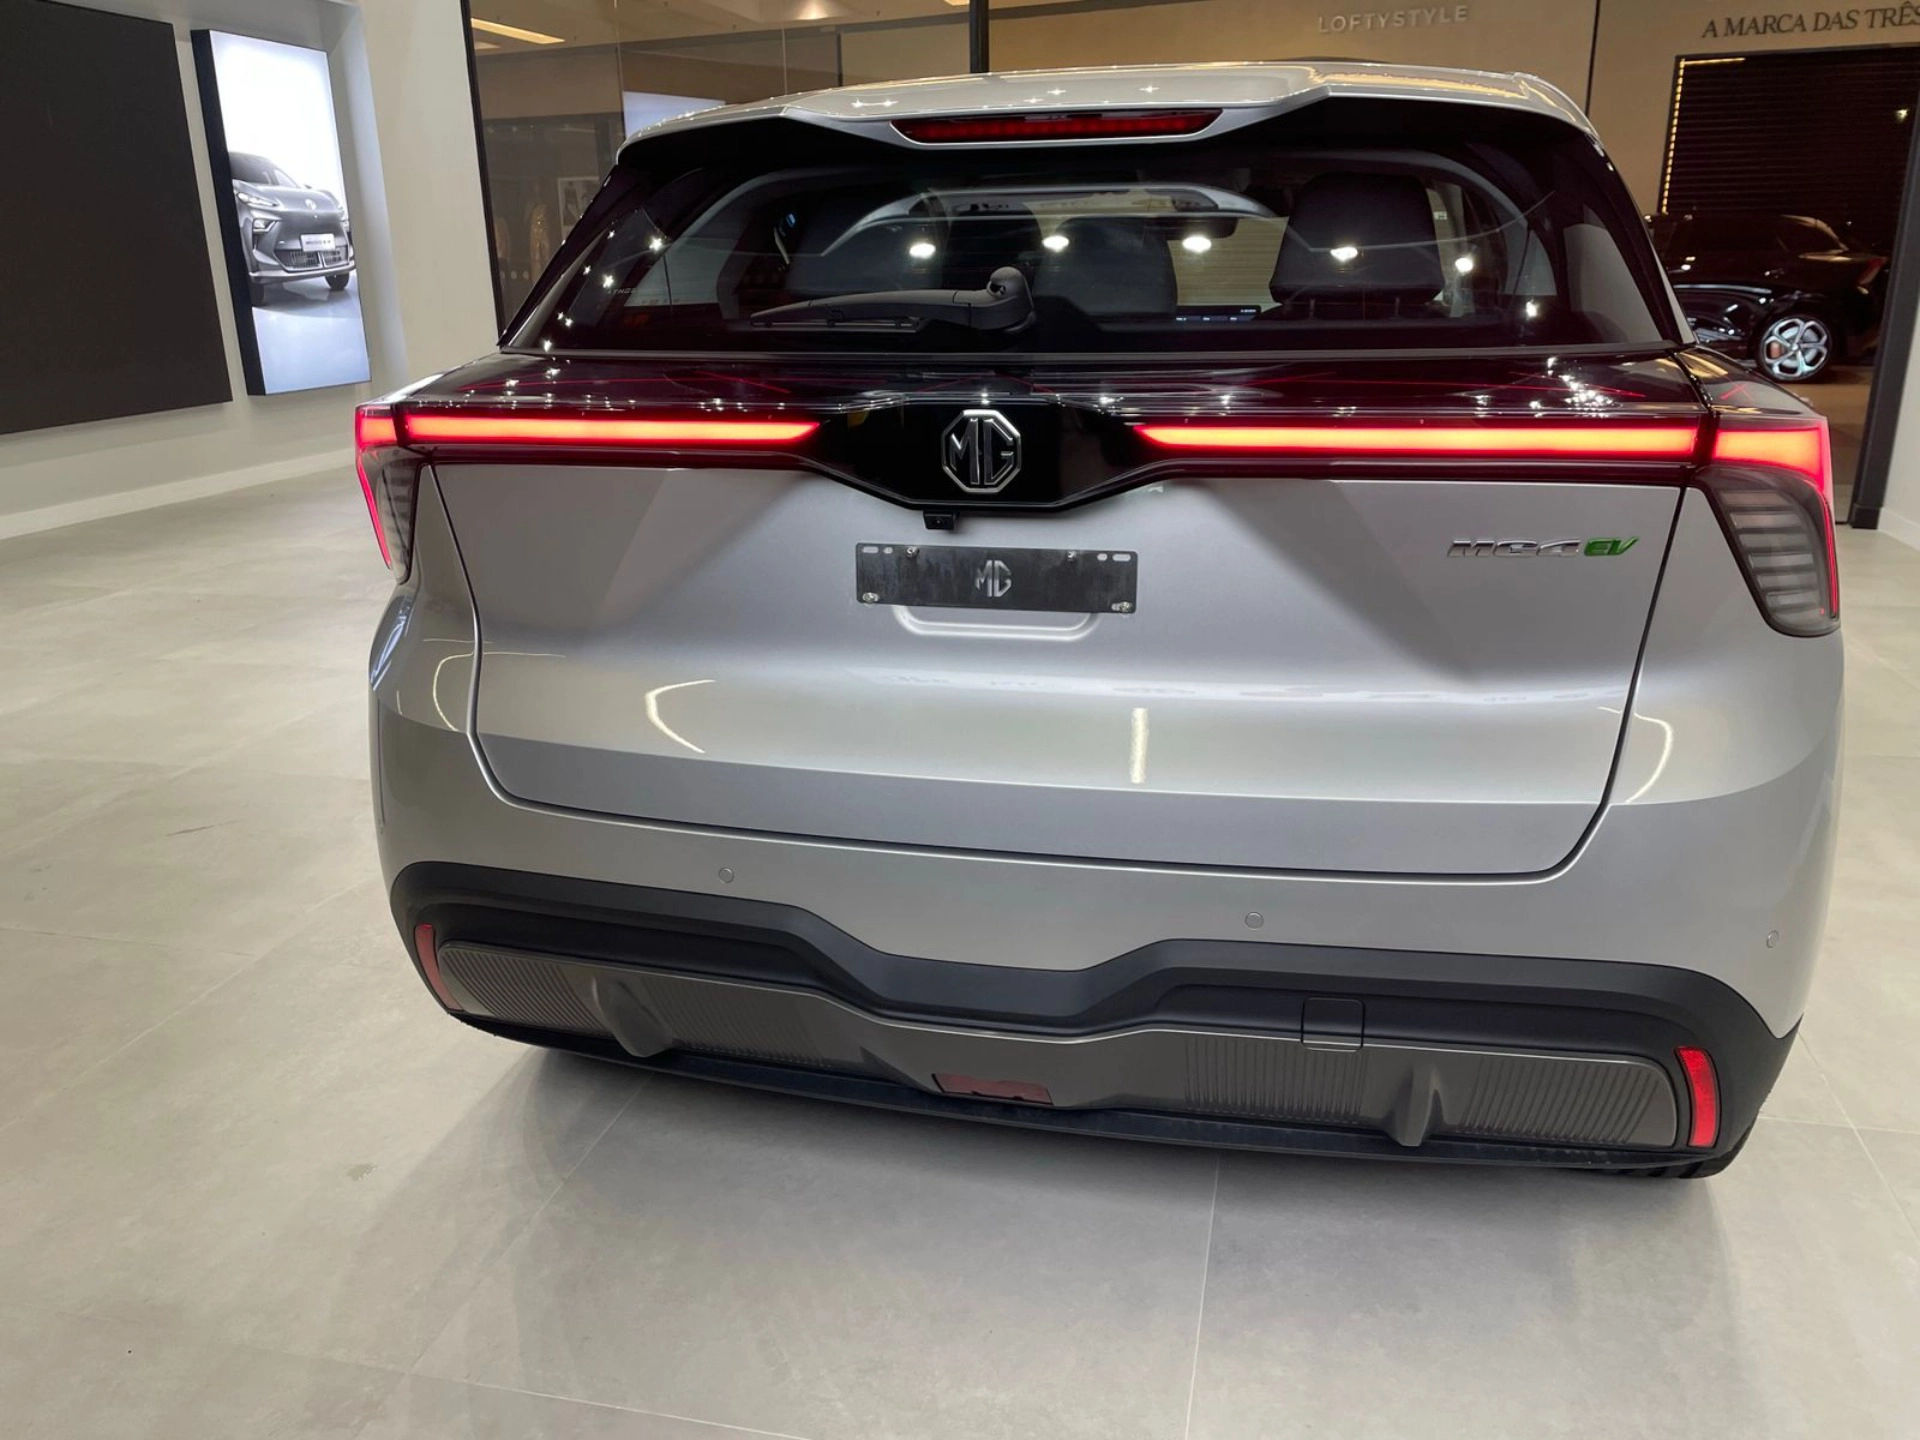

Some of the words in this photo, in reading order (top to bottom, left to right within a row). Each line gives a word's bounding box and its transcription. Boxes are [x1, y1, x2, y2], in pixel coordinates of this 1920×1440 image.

[1318, 5, 1468, 34] LOFTYSTYLE
[1701, 19, 1718, 38] A
[1723, 14, 1806, 37] MARCA
[1812, 9, 1860, 32] DAS
[949, 417, 1015, 486] MG
[975, 559, 1012, 597] MG
